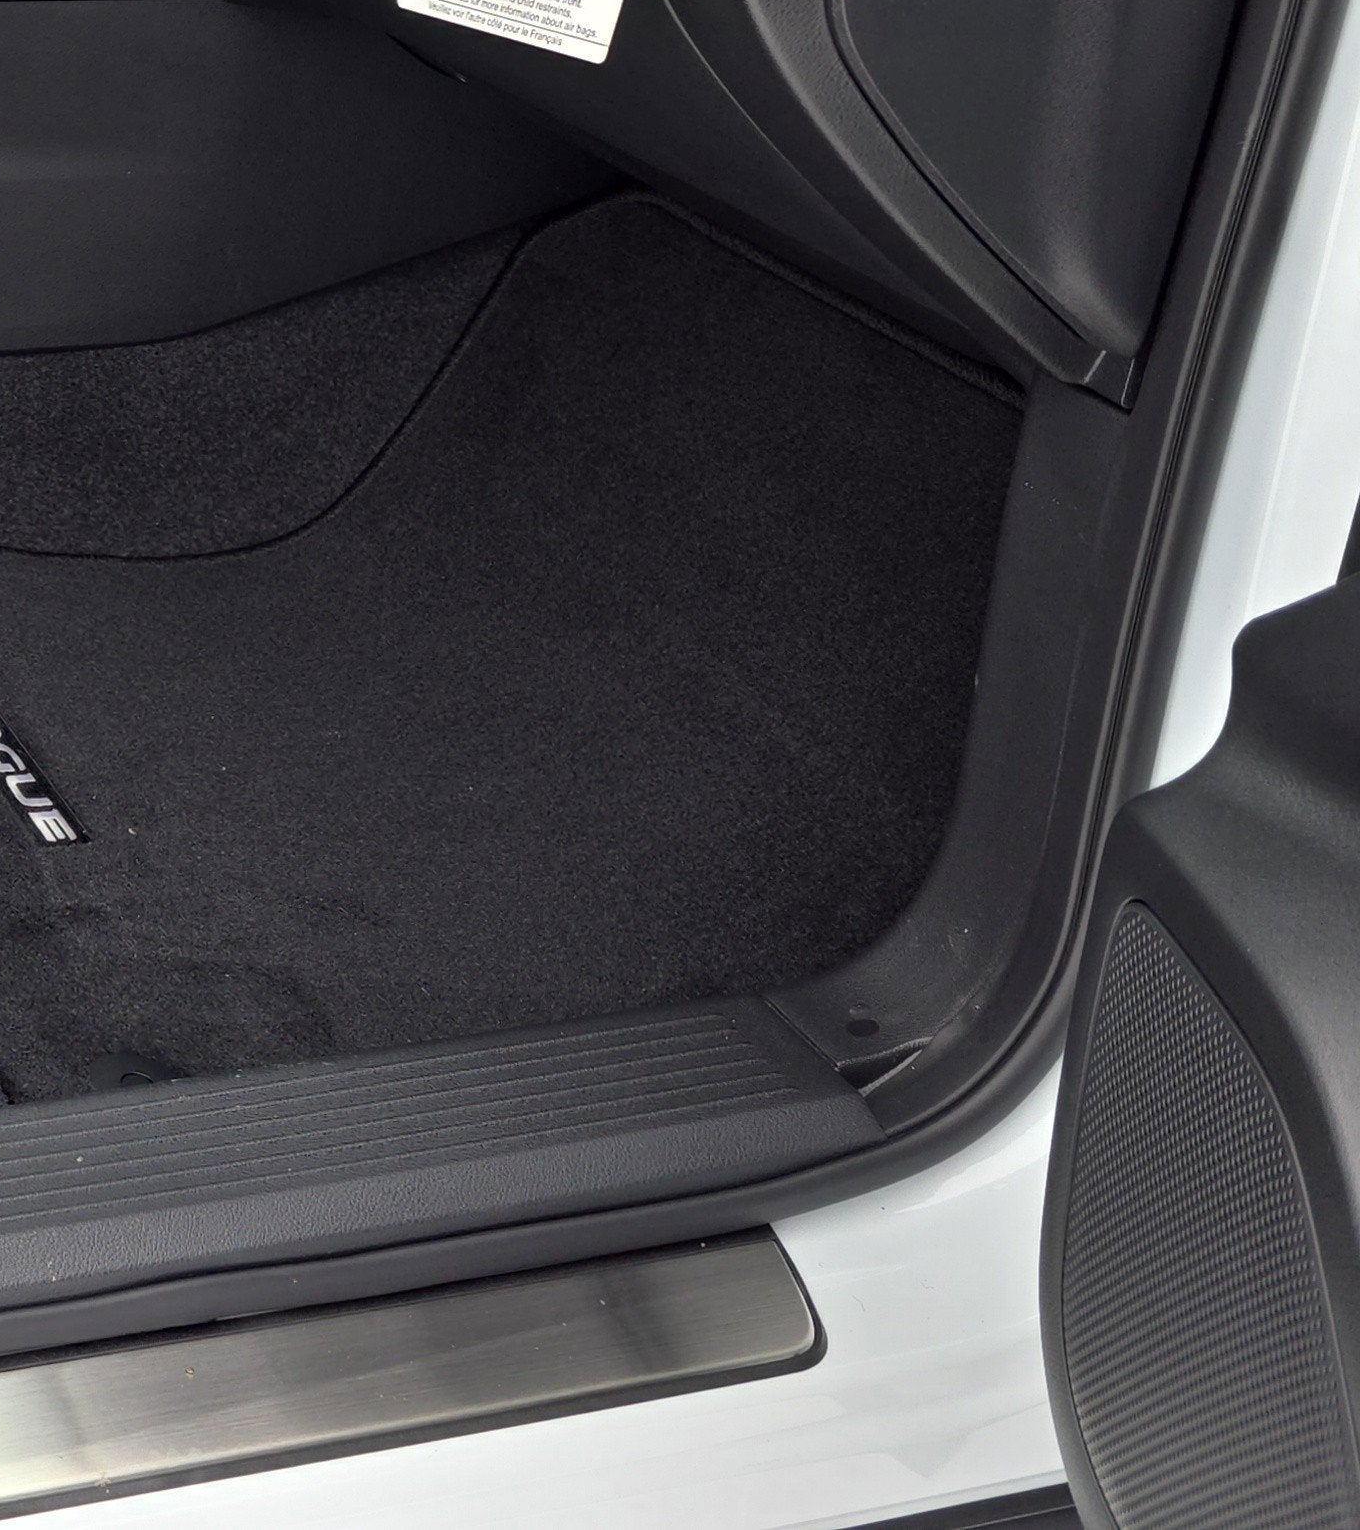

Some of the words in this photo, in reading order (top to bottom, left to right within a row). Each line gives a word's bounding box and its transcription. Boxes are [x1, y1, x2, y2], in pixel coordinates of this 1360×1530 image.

[481, 0, 499, 11] more
[500, 4, 540, 22] information
[540, 16, 563, 29] about
[564, 22, 575, 32] air
[576, 25, 597, 38] bags.
[535, 1, 572, 18] restraints.
[504, 23, 521, 34] pour
[521, 27, 529, 36] le
[530, 29, 563, 46] Français
